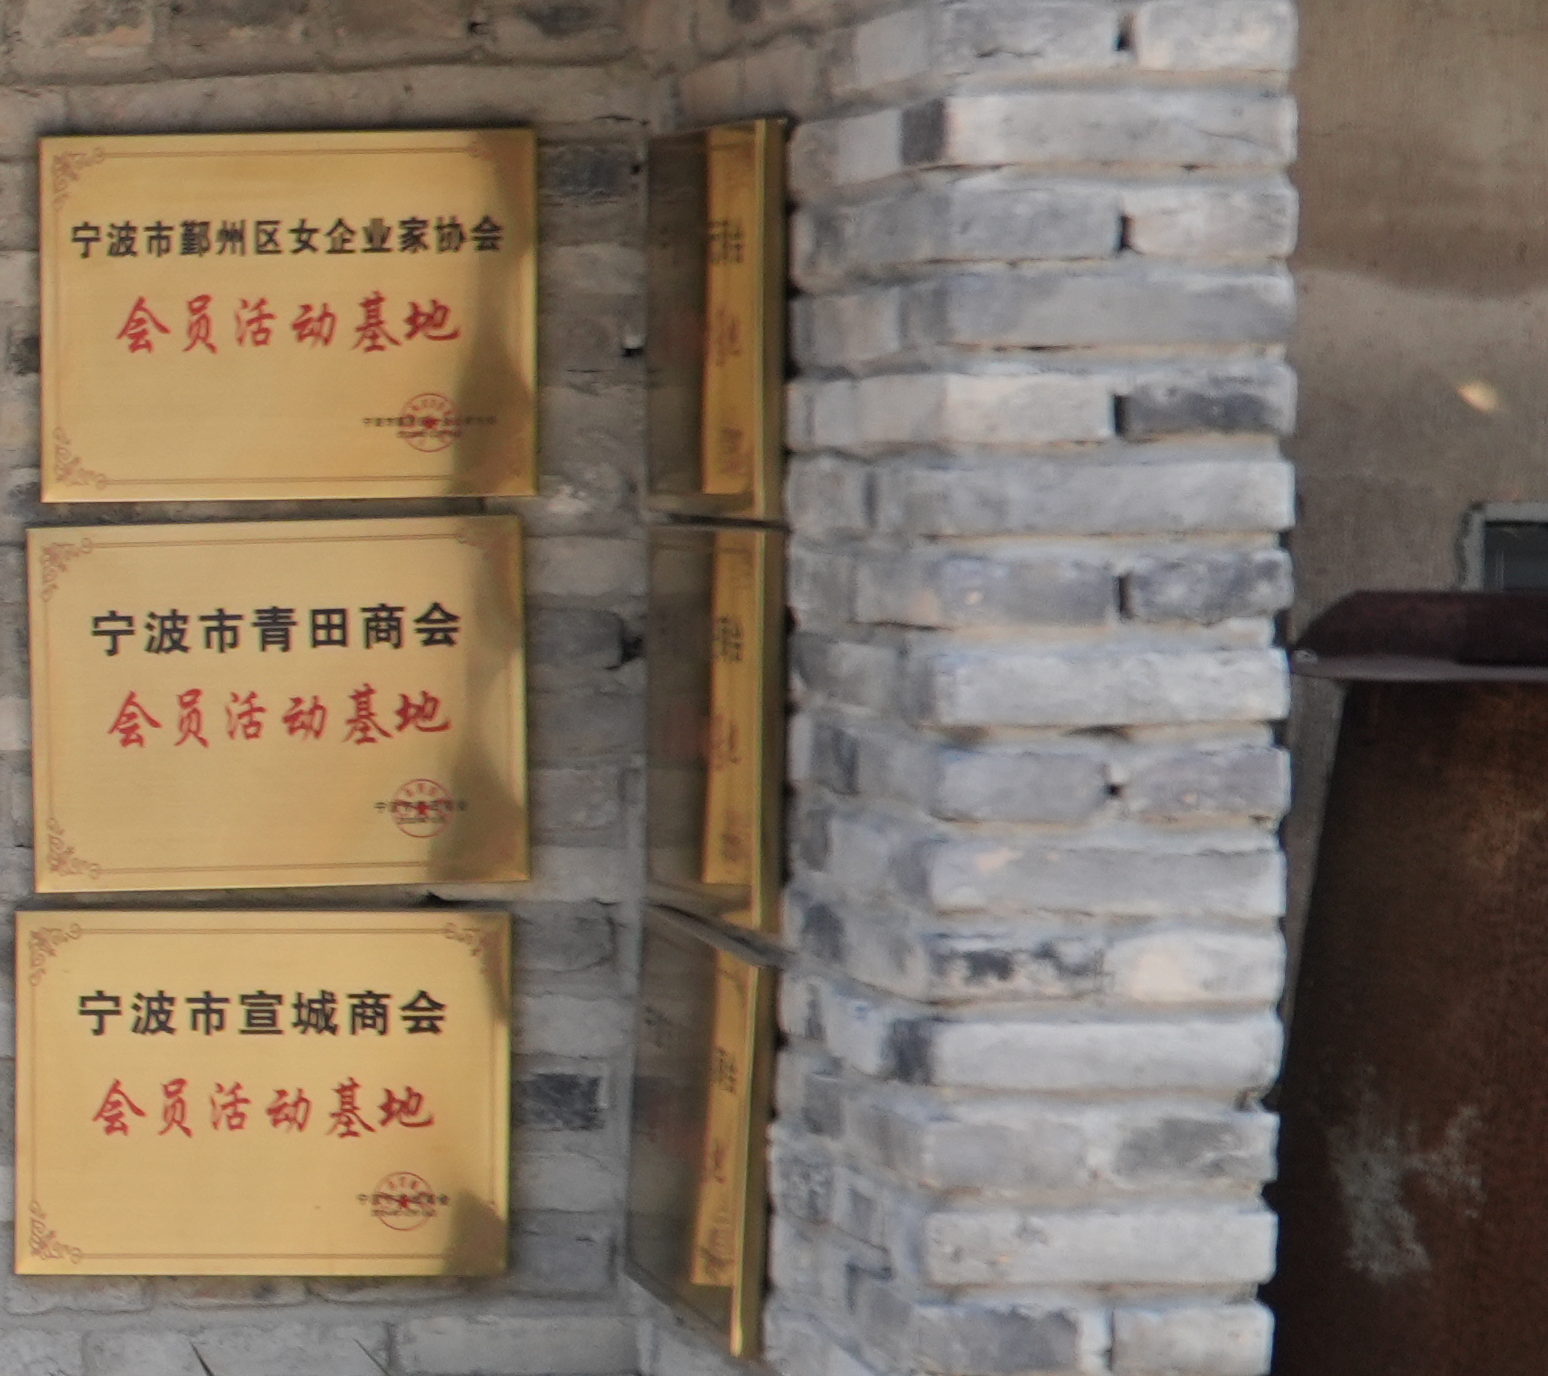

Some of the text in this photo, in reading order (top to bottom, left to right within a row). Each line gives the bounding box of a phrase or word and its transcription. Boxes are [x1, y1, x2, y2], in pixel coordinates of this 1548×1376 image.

[70, 214, 505, 259] 宁波市鄞州区女企业家协会
[115, 290, 461, 354] 会员活动基地
[91, 601, 461, 657] 宁波市青田商会
[107, 682, 452, 749] 会员活动基地
[77, 988, 447, 1037] 宁波市宣城商会
[91, 1076, 436, 1139] 会员活动基地
